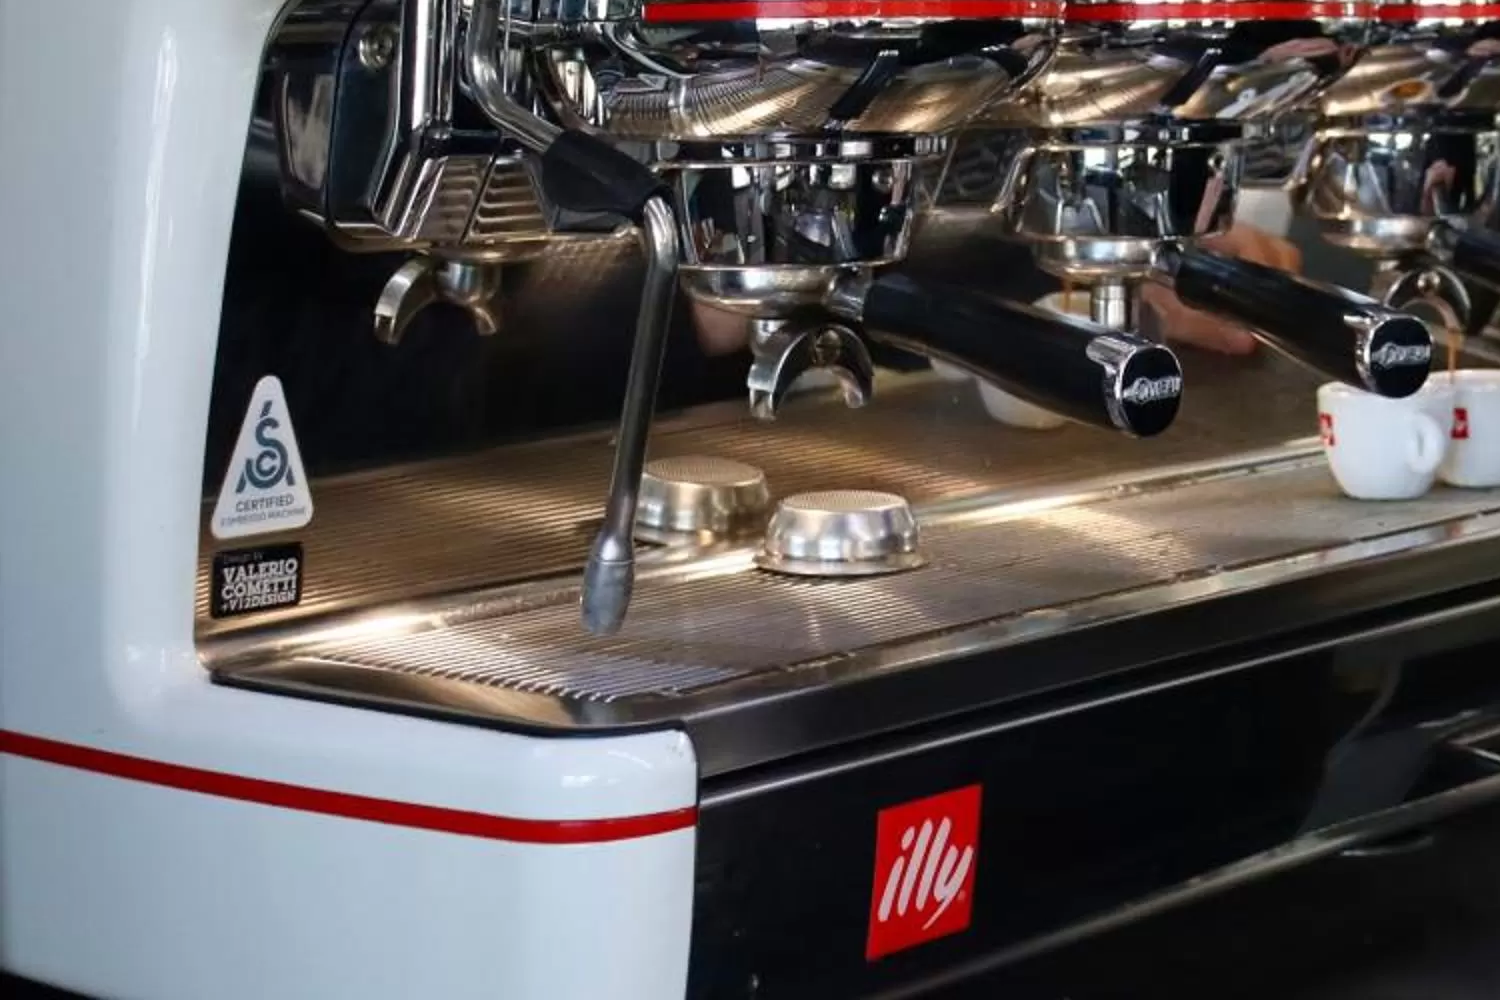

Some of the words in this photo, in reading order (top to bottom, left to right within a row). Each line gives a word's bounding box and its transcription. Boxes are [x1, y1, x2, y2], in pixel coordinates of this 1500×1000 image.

[235, 493, 295, 513] CERTIFIED
[223, 557, 298, 583] VALERIO
[221, 574, 297, 600] COMETTI
[878, 816, 974, 931] illy
